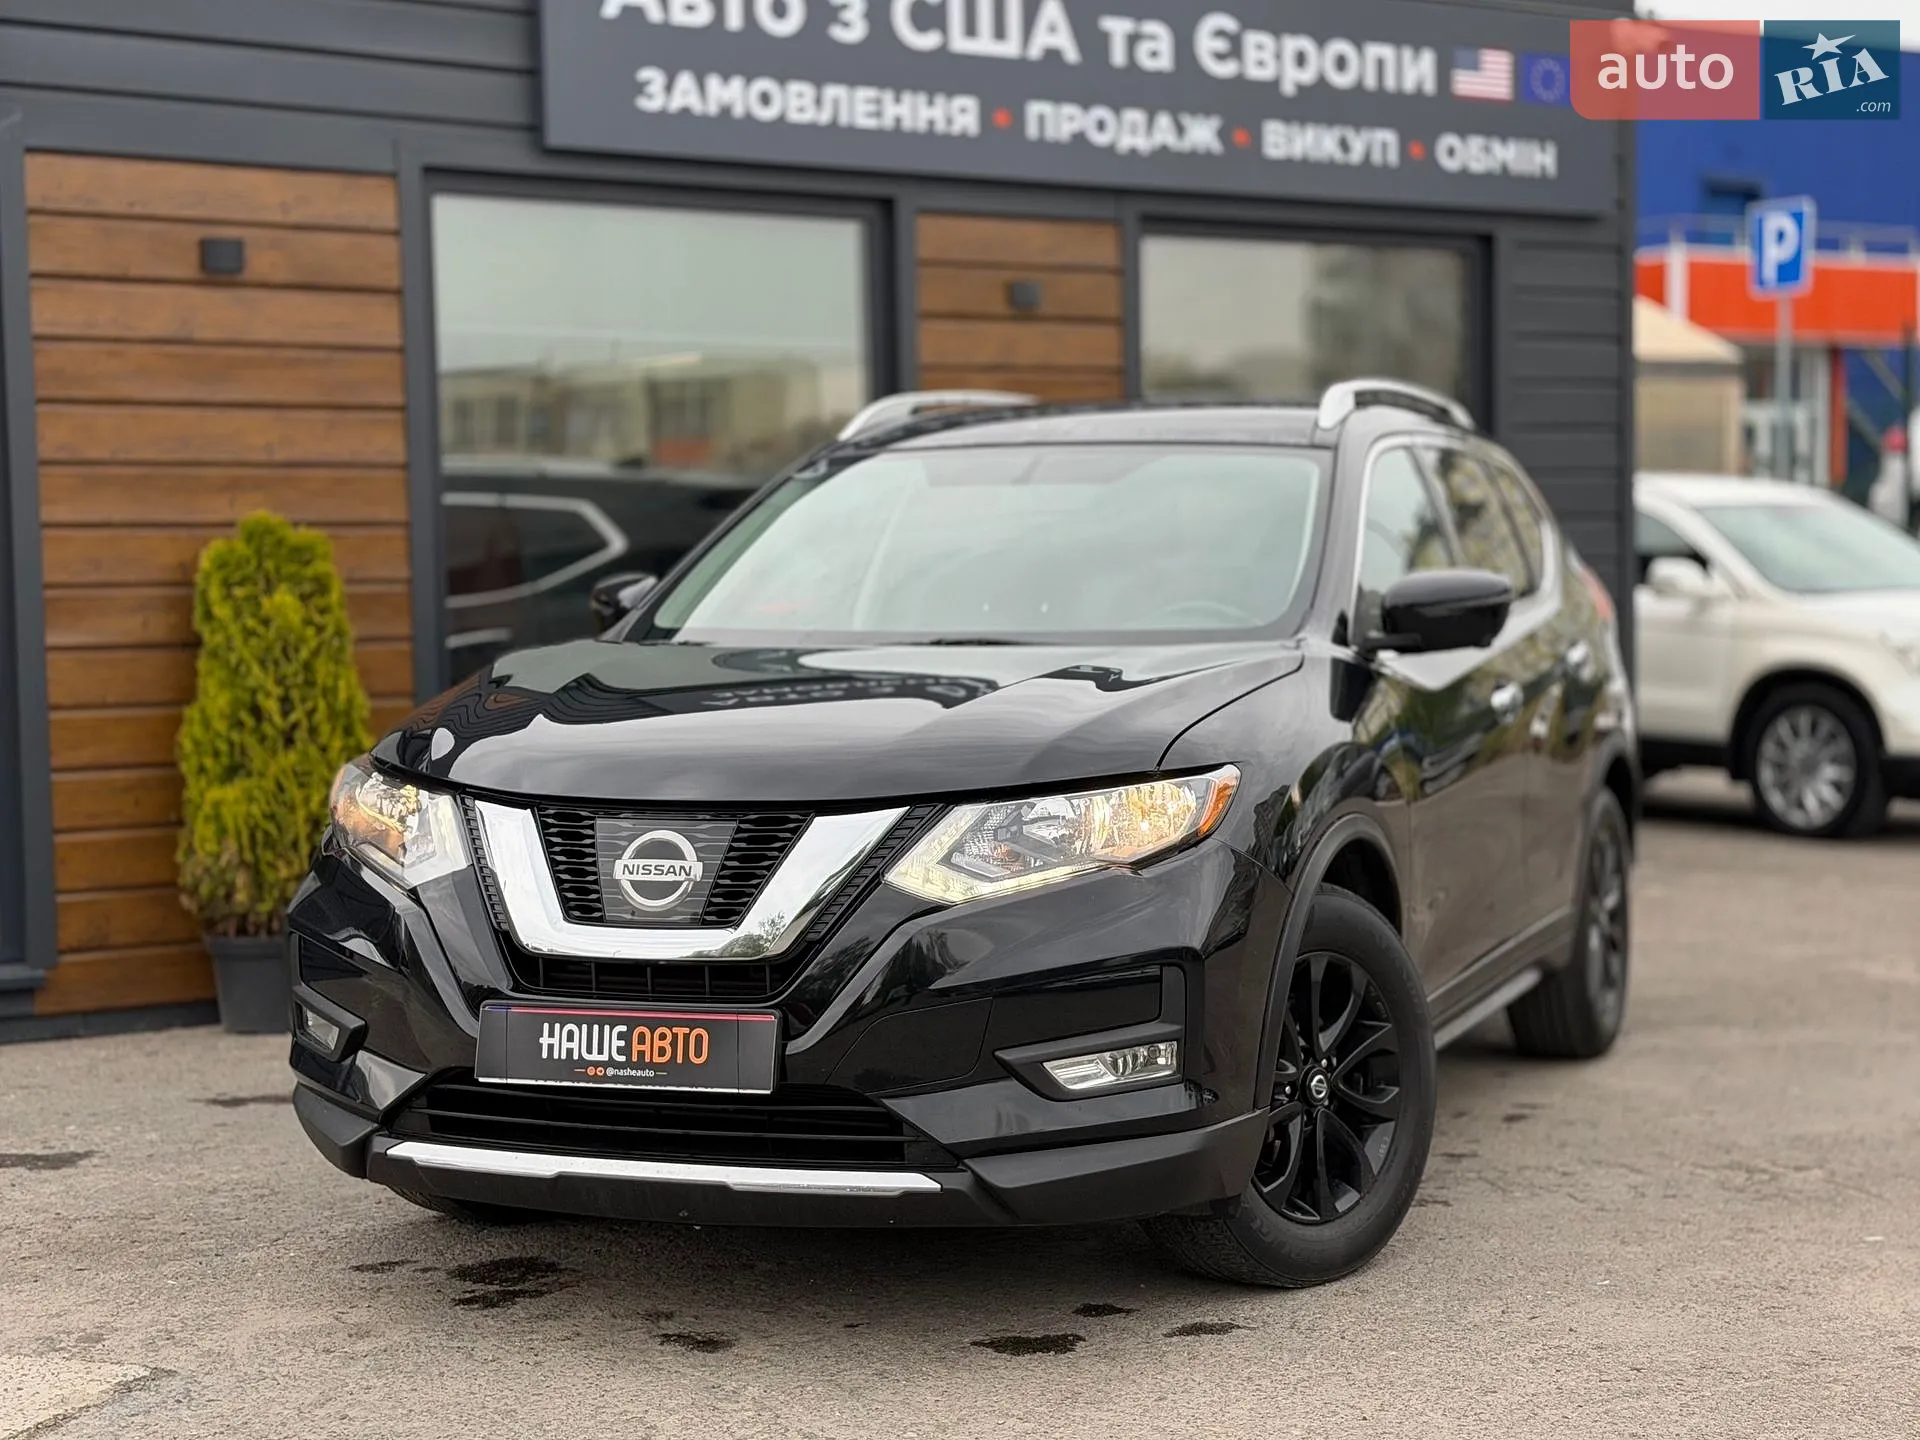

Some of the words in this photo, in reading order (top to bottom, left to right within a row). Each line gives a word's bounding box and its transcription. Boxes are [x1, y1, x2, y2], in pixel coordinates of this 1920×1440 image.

[890, 0, 1083, 65] США
[1097, 13, 1176, 73] та
[1193, 10, 1438, 97] Європи
[634, 65, 982, 138] ЗАМОВЛЕННЯ
[1023, 98, 1224, 156] ПРОДАЖ
[1261, 118, 1400, 169] ВИКУП
[1434, 133, 1558, 179] ОБМІН
[1761, 209, 1799, 289] P
[622, 864, 692, 877] NISSAN
[539, 1023, 628, 1061] НАШЕ
[632, 1026, 709, 1064] АВТО
[605, 1066, 655, 1078] @nasheauto
